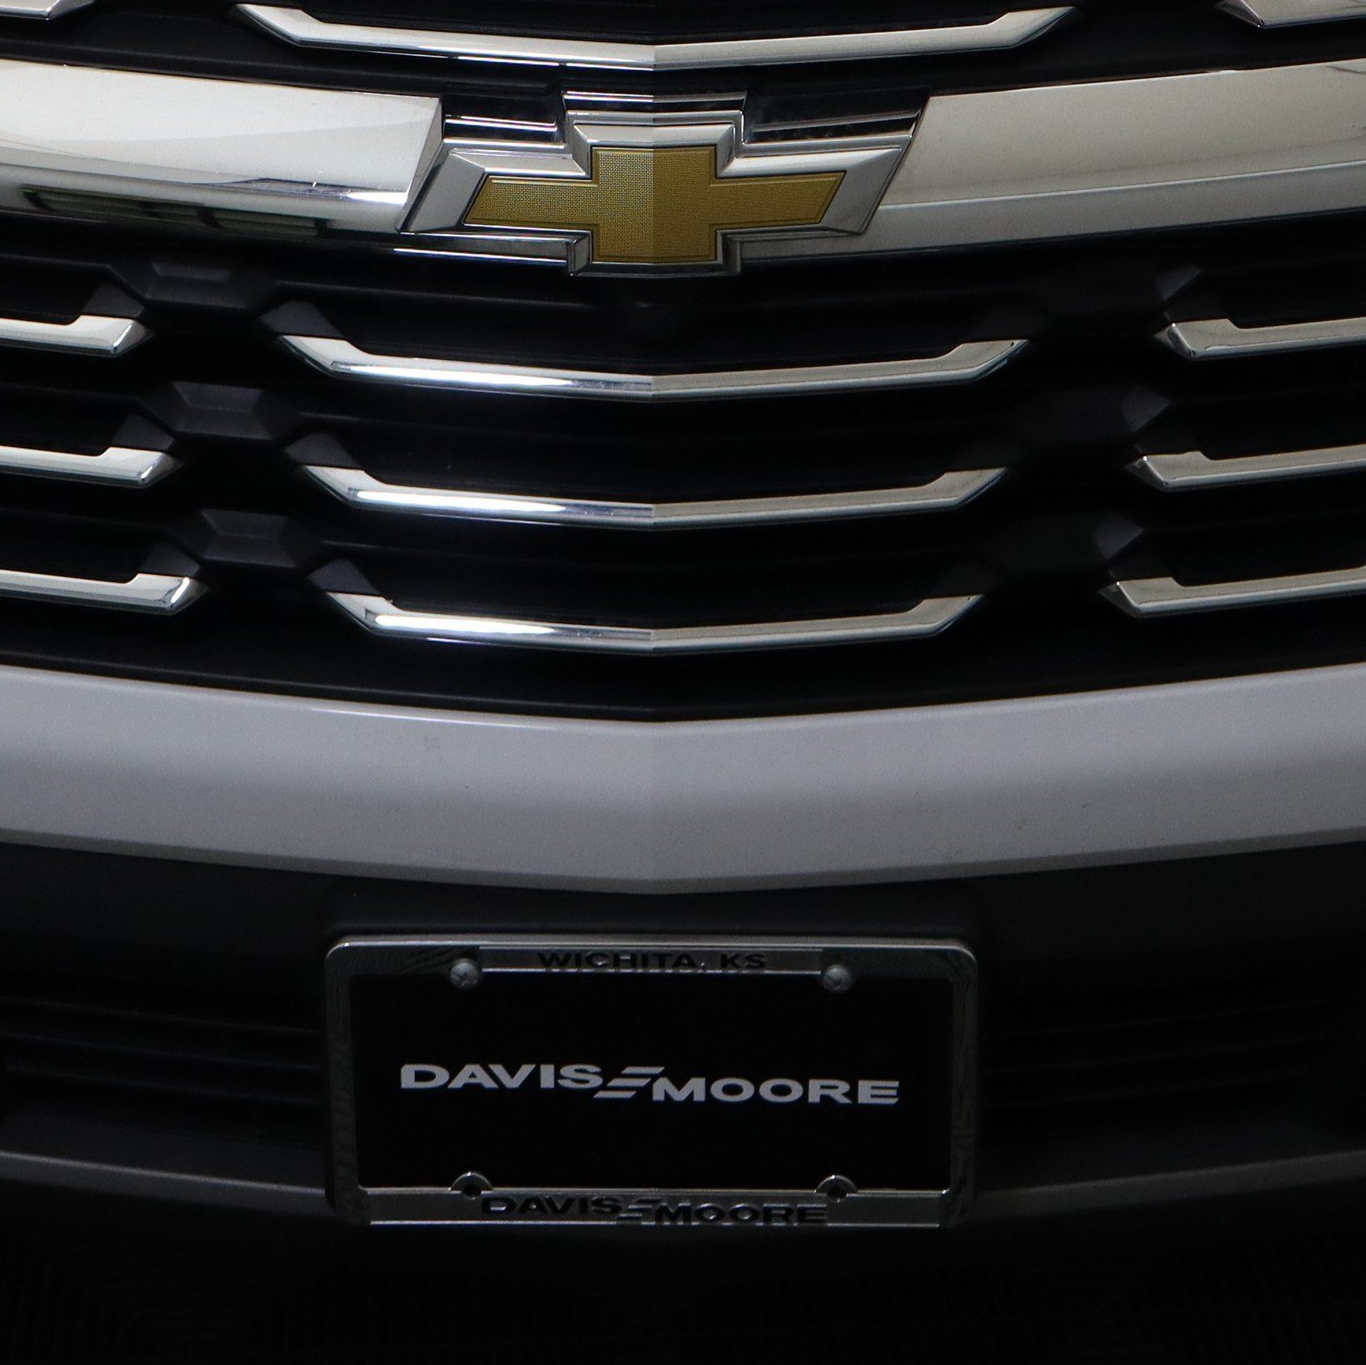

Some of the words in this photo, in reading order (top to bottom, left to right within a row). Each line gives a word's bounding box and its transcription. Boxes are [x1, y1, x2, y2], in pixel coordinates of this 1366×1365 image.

[719, 952, 766, 970] KS
[400, 1063, 605, 1089] DAVIS
[651, 1078, 900, 1104] MOORE
[480, 1197, 623, 1216] DAVIS
[655, 1202, 828, 1225] MOORE
